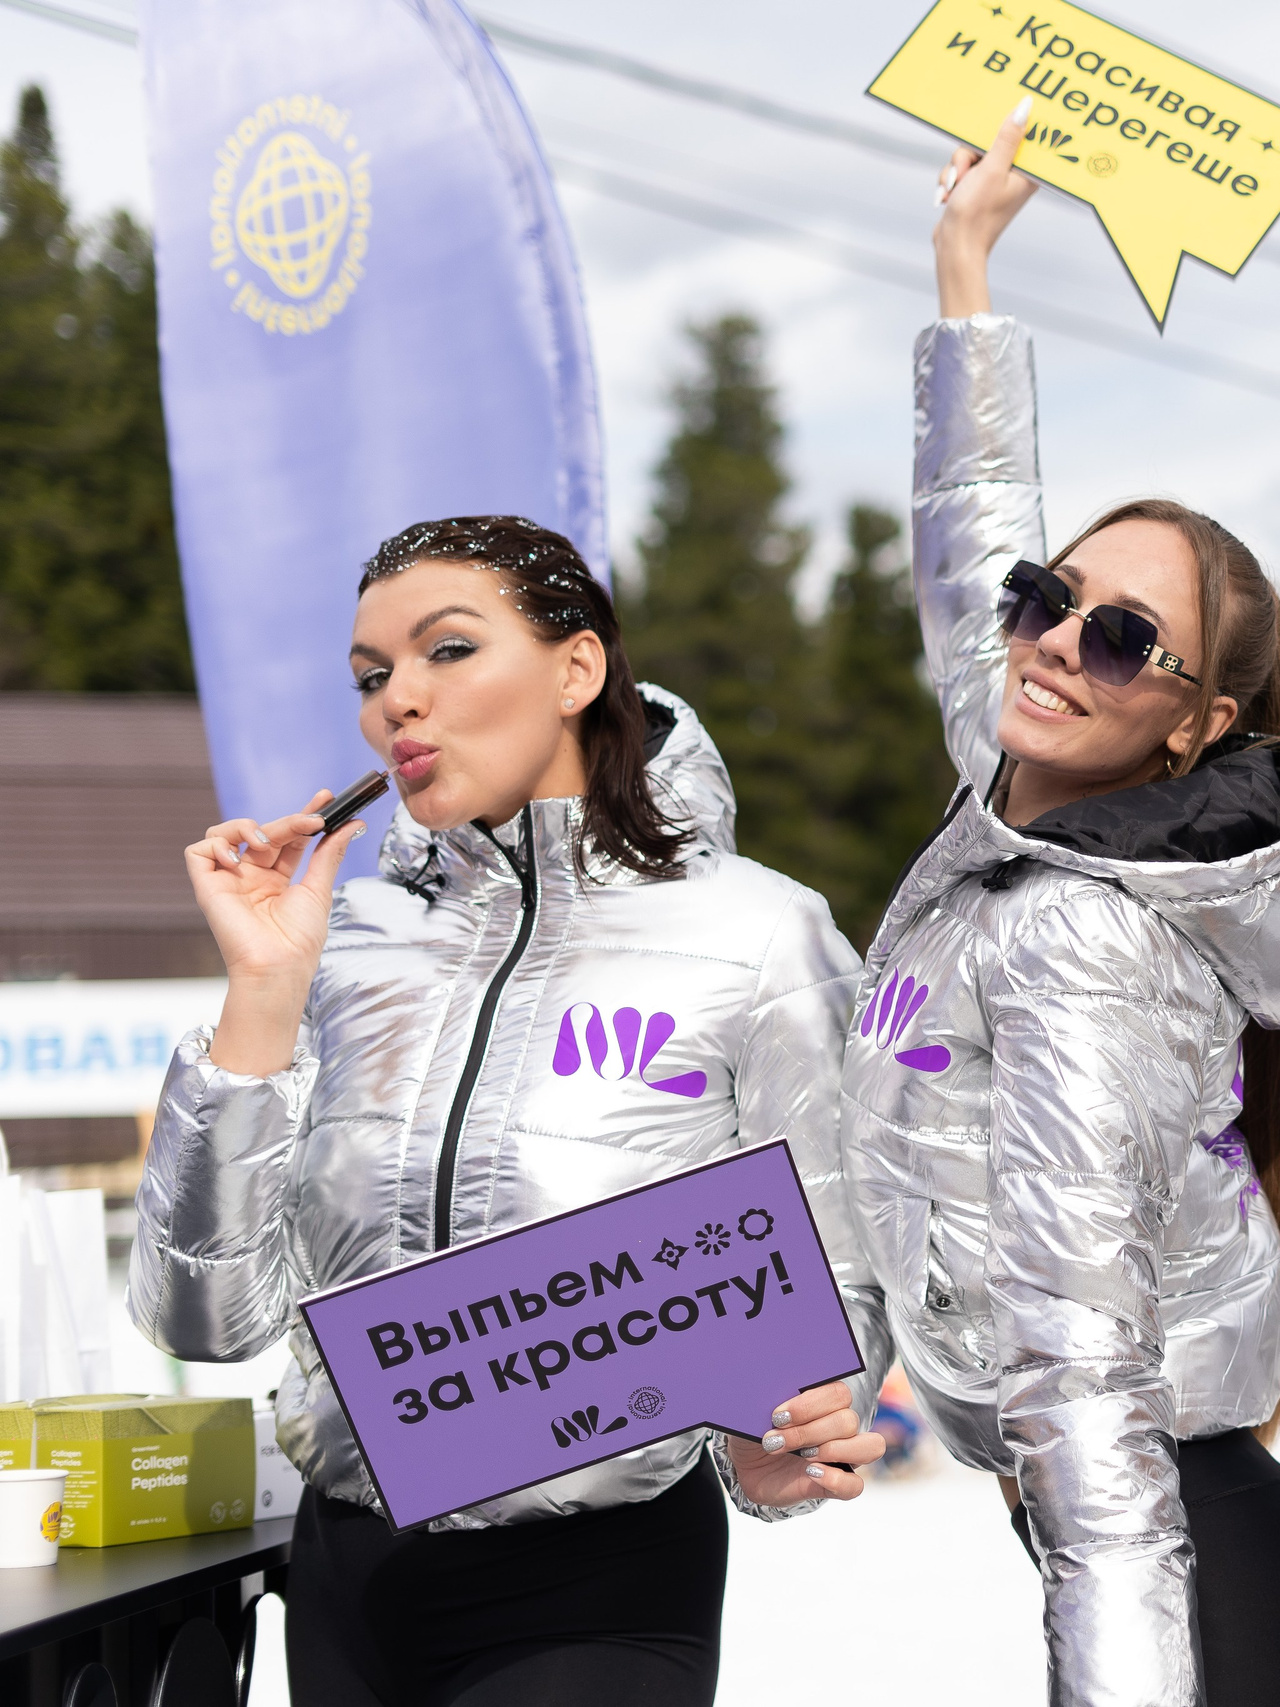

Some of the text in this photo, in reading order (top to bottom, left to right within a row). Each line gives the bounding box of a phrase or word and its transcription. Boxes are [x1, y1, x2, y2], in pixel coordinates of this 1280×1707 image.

[946, 32, 977, 57] и
[983, 50, 1011, 73] в
[1019, 62, 1259, 196] Шерегеше
[1016, 15, 1241, 142] Красивая
[366, 1251, 645, 1371] Выпьем
[391, 1250, 794, 1425] за красоту!
[131, 1455, 189, 1471] Collagen
[131, 1472, 188, 1491] Peptides
